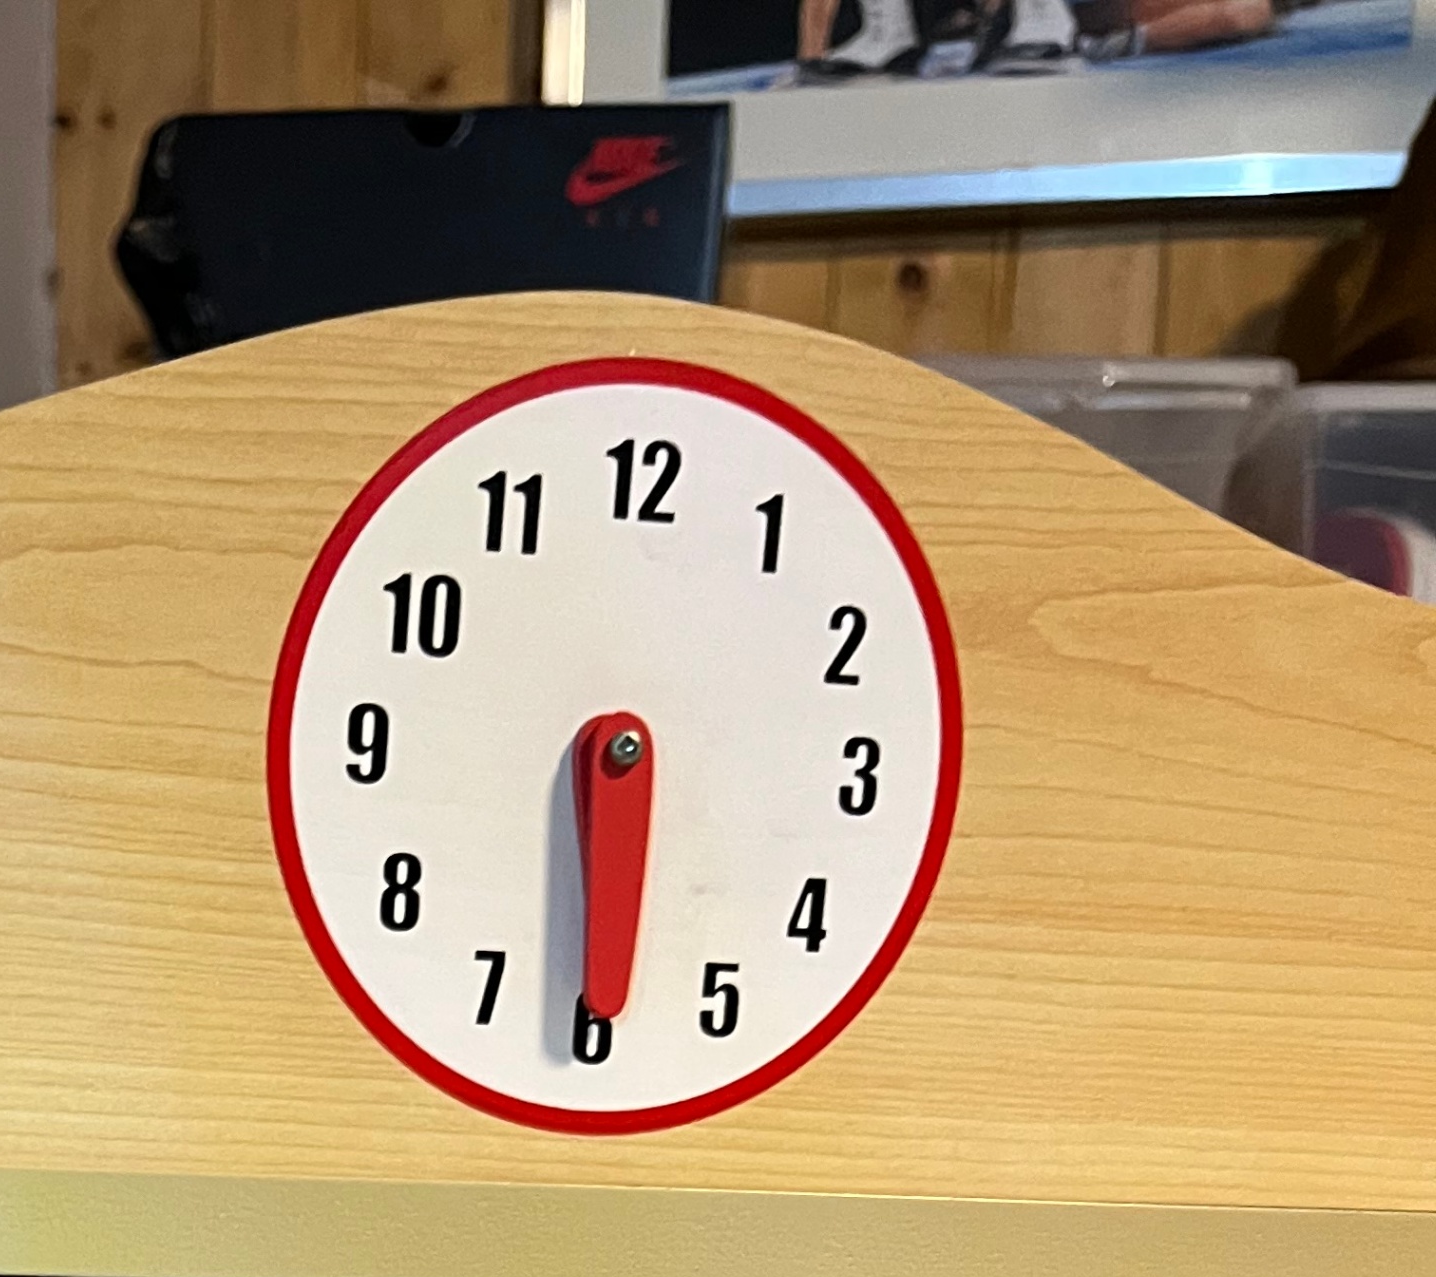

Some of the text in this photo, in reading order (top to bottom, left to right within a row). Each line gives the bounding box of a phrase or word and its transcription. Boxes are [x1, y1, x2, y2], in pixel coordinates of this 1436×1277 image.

[478, 470, 543, 555] 11
[606, 439, 682, 524] 12
[755, 494, 784, 574] 1
[383, 573, 462, 658] 10
[823, 605, 867, 686] 2
[345, 702, 389, 785] 9
[838, 736, 880, 816] 3
[380, 852, 422, 932] 8
[787, 877, 827, 953] 4
[474, 950, 506, 1025] 7
[699, 962, 740, 1038] 5
[572, 992, 613, 1065] 6
